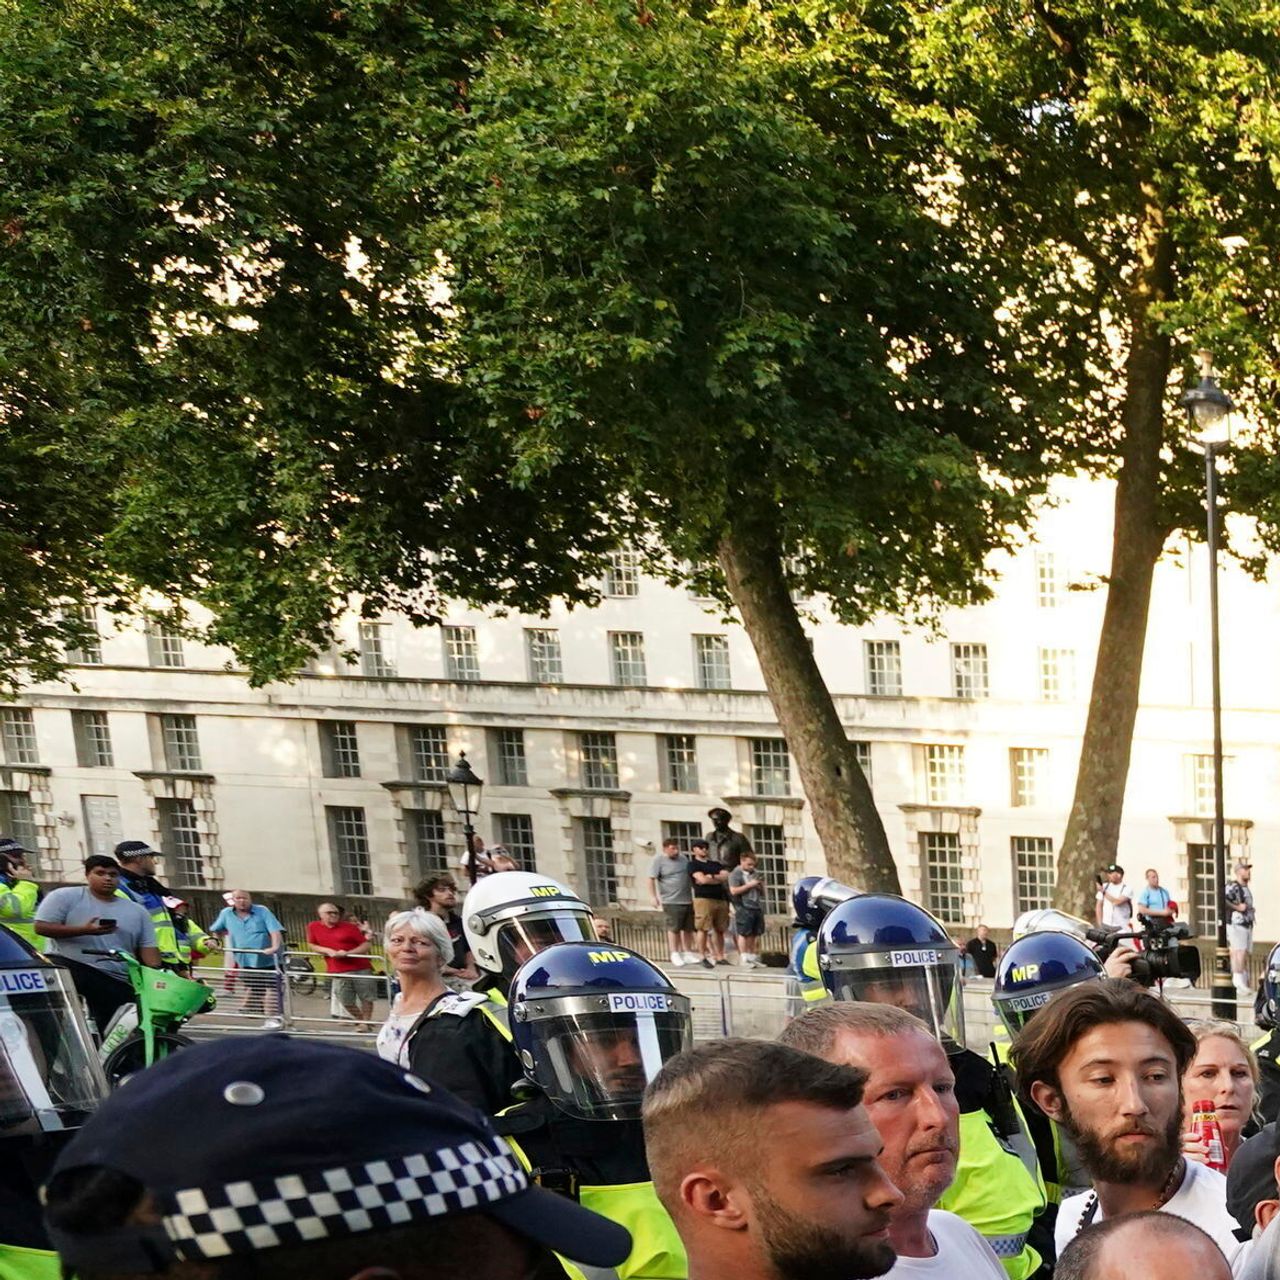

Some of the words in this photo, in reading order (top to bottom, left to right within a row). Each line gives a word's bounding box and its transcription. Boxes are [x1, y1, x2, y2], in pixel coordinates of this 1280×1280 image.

[531, 886, 560, 897] MP
[588, 951, 631, 964] MP
[895, 951, 936, 964] POLICE
[1012, 964, 1040, 983] MP
[0, 973, 44, 991] LICE
[613, 995, 664, 1009] POLICE
[1014, 993, 1048, 1010] POLICE
